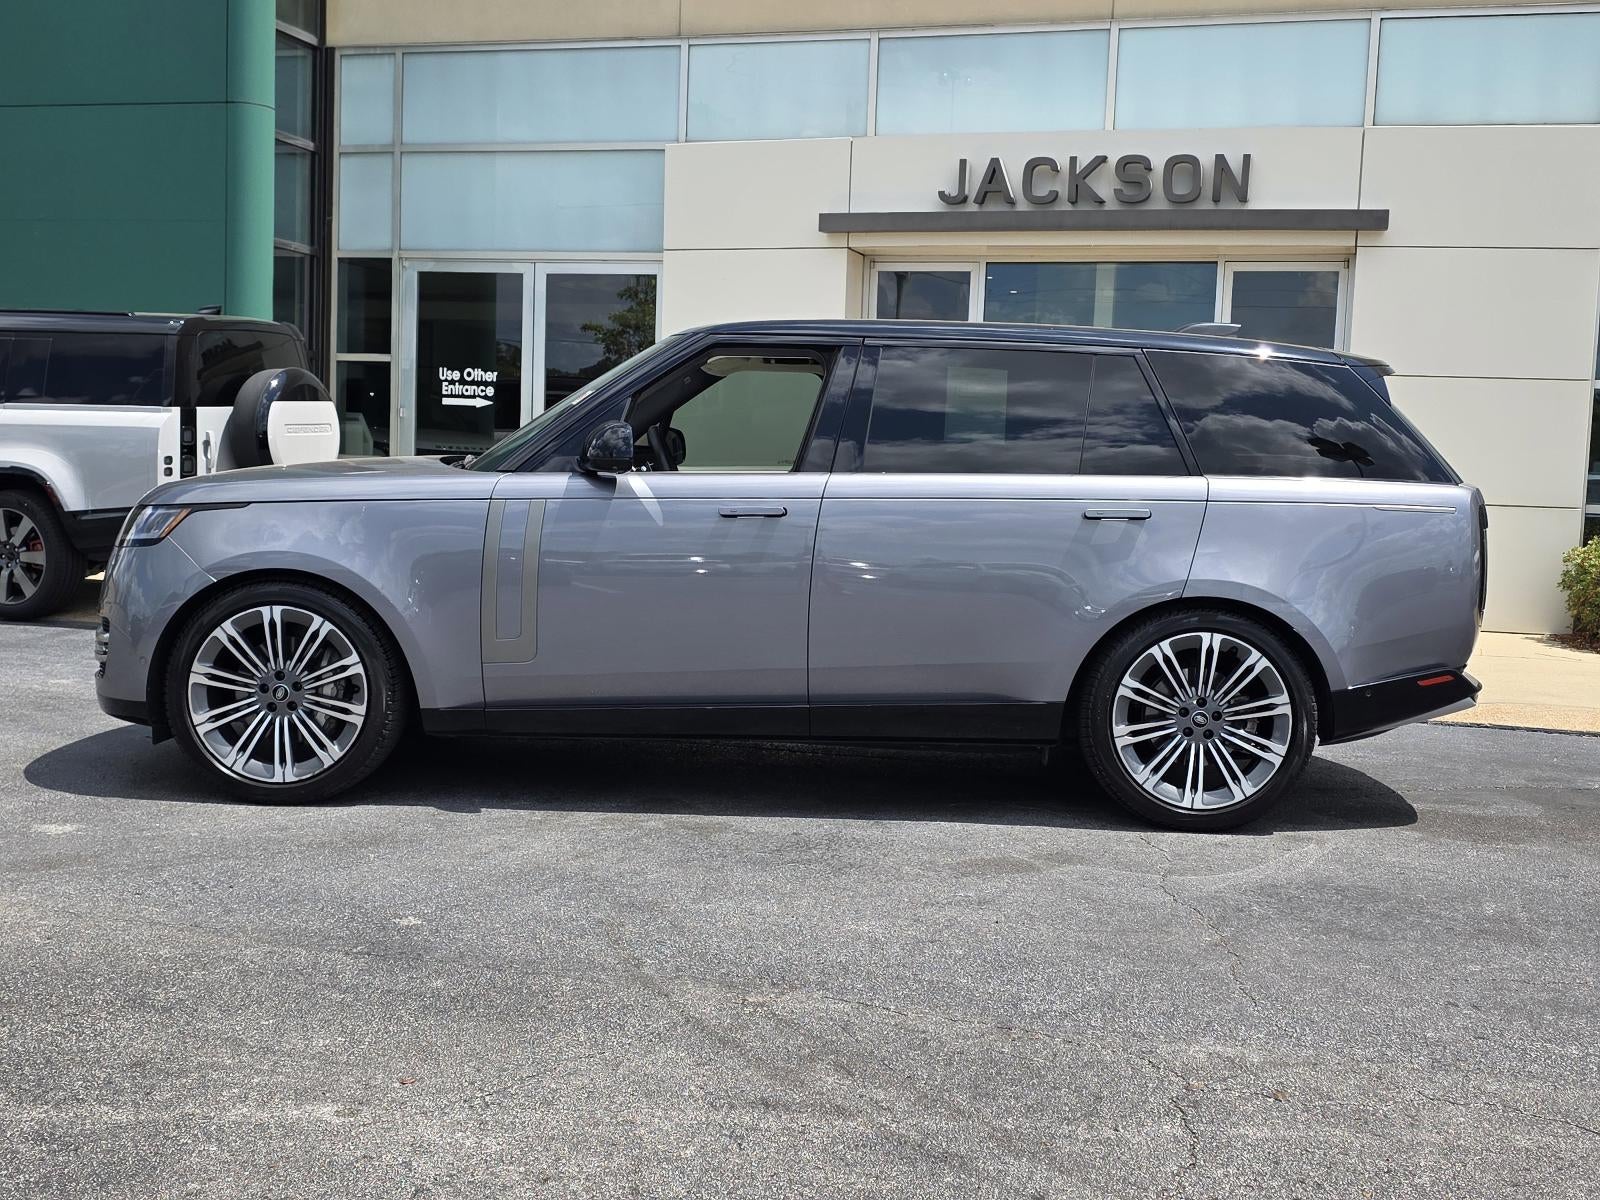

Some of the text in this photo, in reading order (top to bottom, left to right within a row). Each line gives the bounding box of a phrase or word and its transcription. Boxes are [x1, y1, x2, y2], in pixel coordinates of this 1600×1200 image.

[937, 153, 1252, 206] JACKSON
[439, 367, 498, 382] Use Other
[442, 382, 494, 397] Entrance
